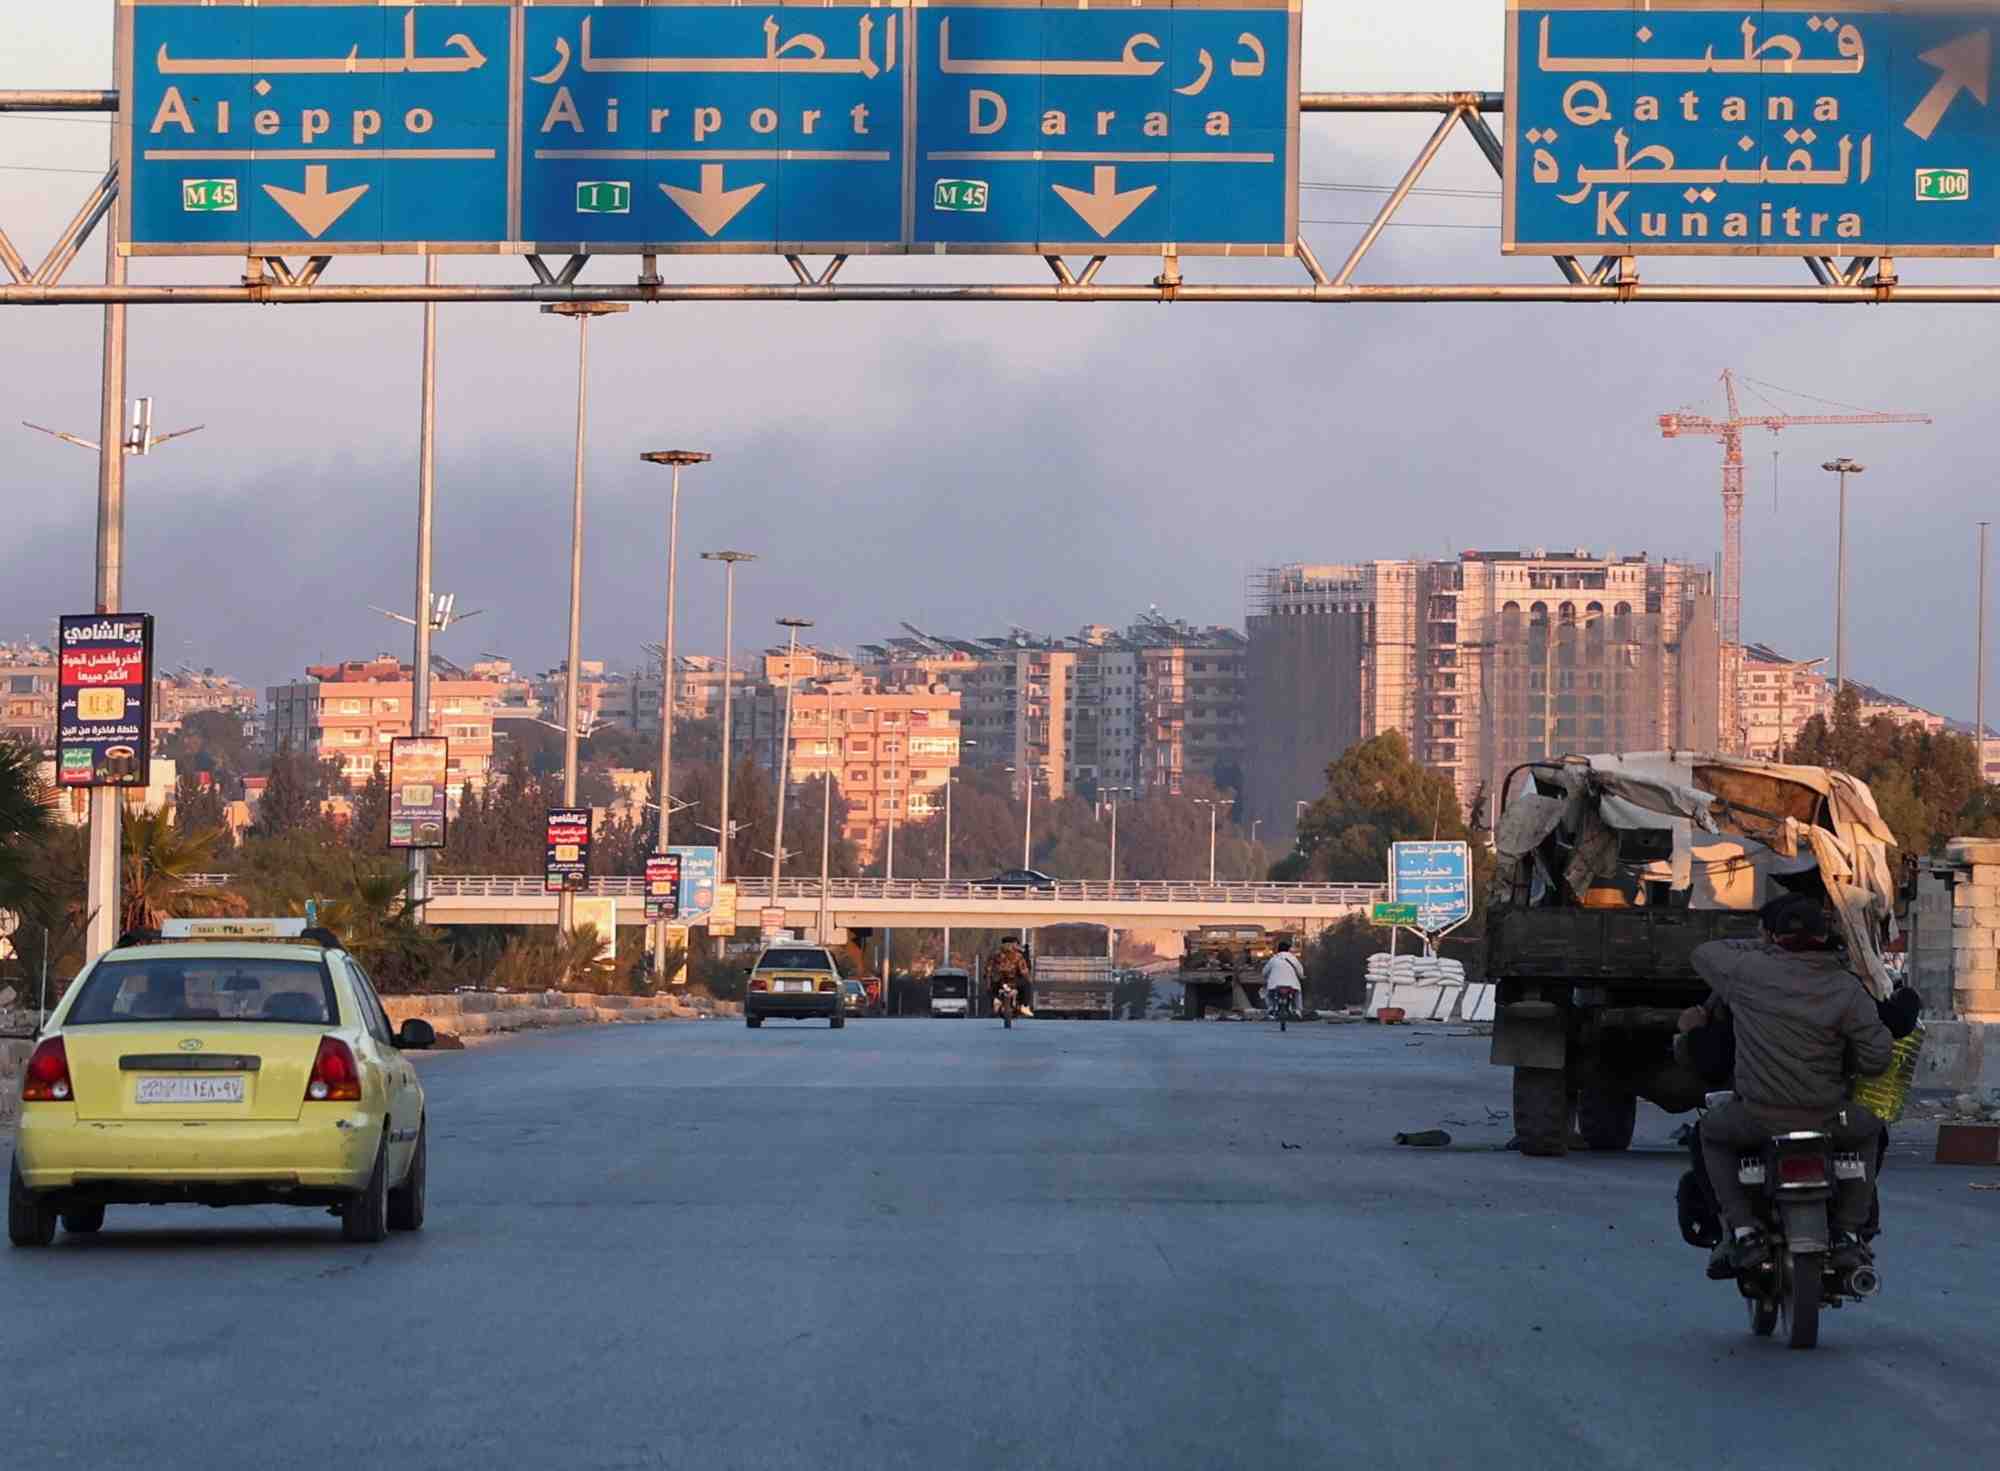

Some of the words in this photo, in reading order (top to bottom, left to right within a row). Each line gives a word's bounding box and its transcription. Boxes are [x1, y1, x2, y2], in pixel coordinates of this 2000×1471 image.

[157, 8, 487, 95] حلب
[530, 14, 897, 84] المطار
[940, 16, 1266, 96] درعا
[1538, 15, 1865, 74] قطنا
[151, 86, 434, 144] Aleppo
[541, 86, 869, 142] Airport
[969, 89, 1231, 136] Daraa
[1562, 80, 1839, 126] Qatana
[1525, 127, 1872, 204] القنيطرة
[1920, 175, 1932, 194] P
[1938, 175, 1965, 194] 100
[187, 186, 206, 205] M
[211, 184, 234, 204] 45
[937, 185, 957, 204] M
[962, 187, 985, 206] 45
[1596, 191, 1863, 237] Kunaitra
[63, 620, 124, 645] الشامي
